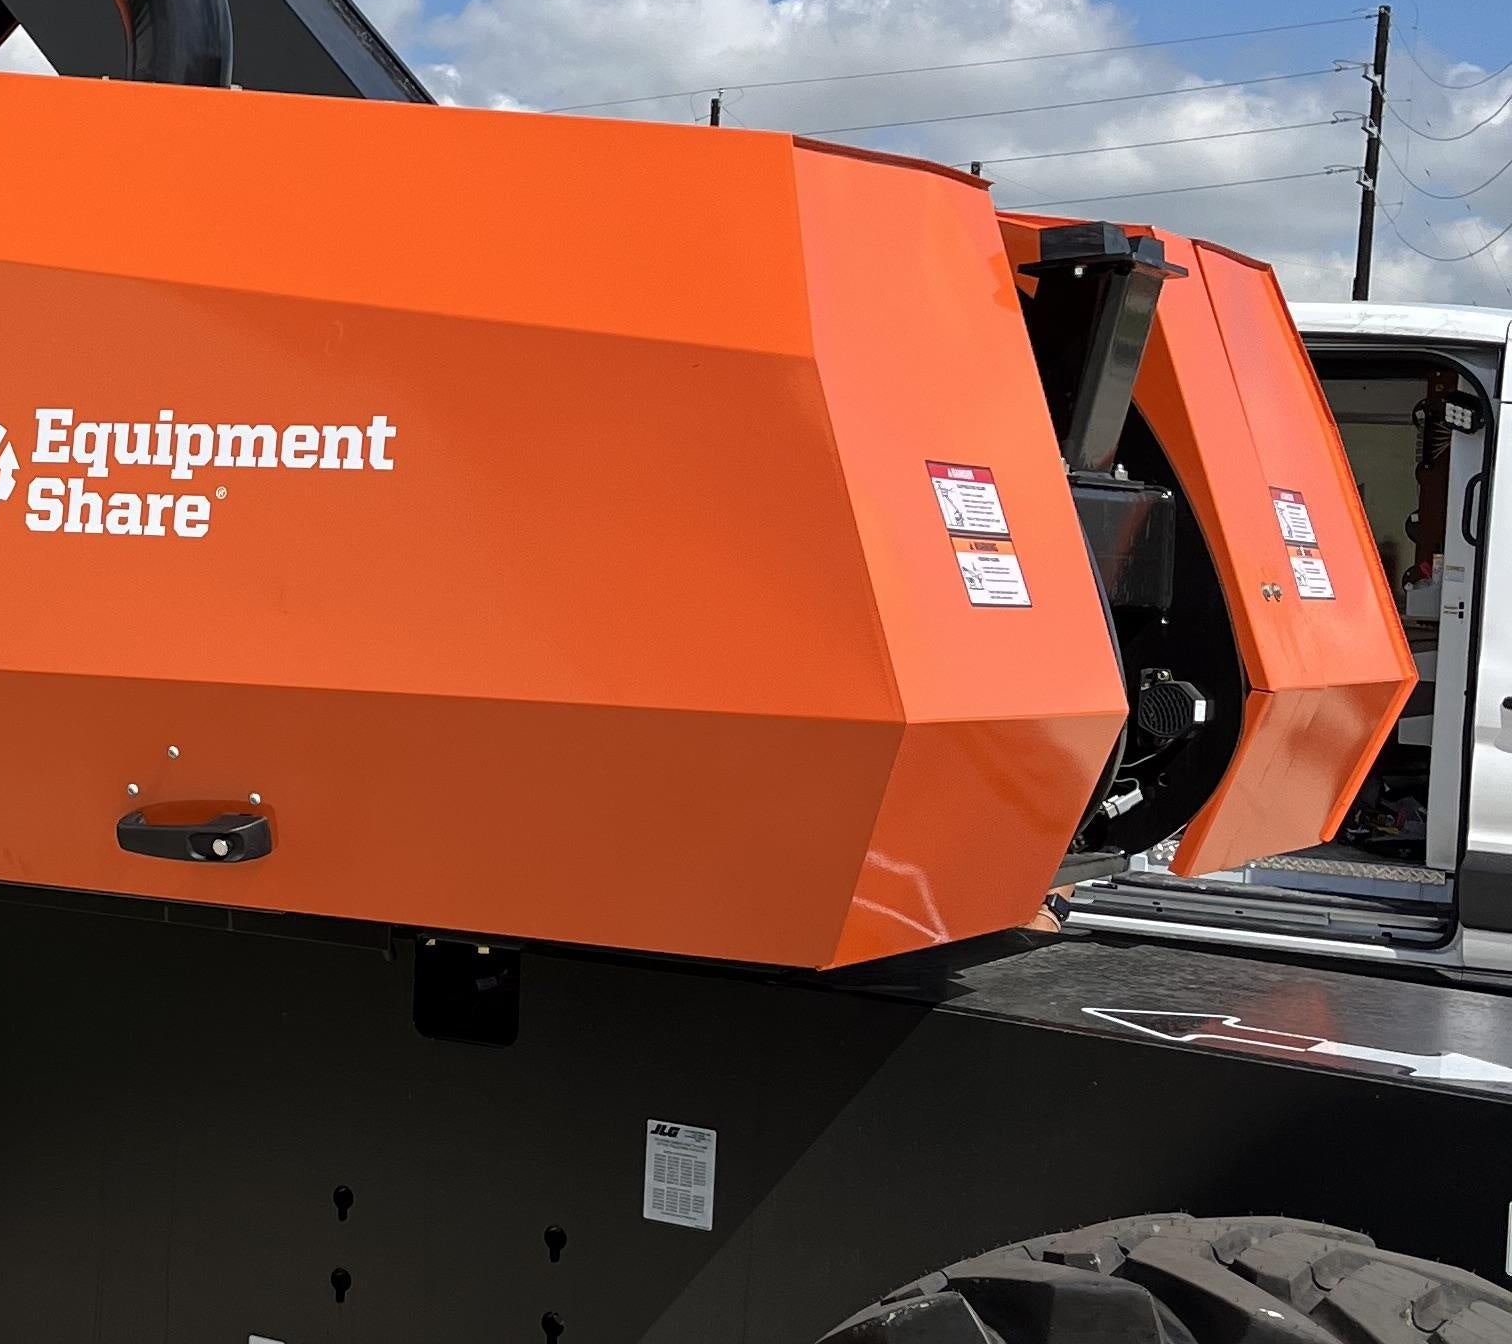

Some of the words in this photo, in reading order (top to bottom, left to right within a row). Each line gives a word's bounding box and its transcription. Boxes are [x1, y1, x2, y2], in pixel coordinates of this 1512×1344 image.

[31, 407, 397, 480] Equipment
[25, 477, 212, 538] Share
[650, 1123, 680, 1138] JLG
